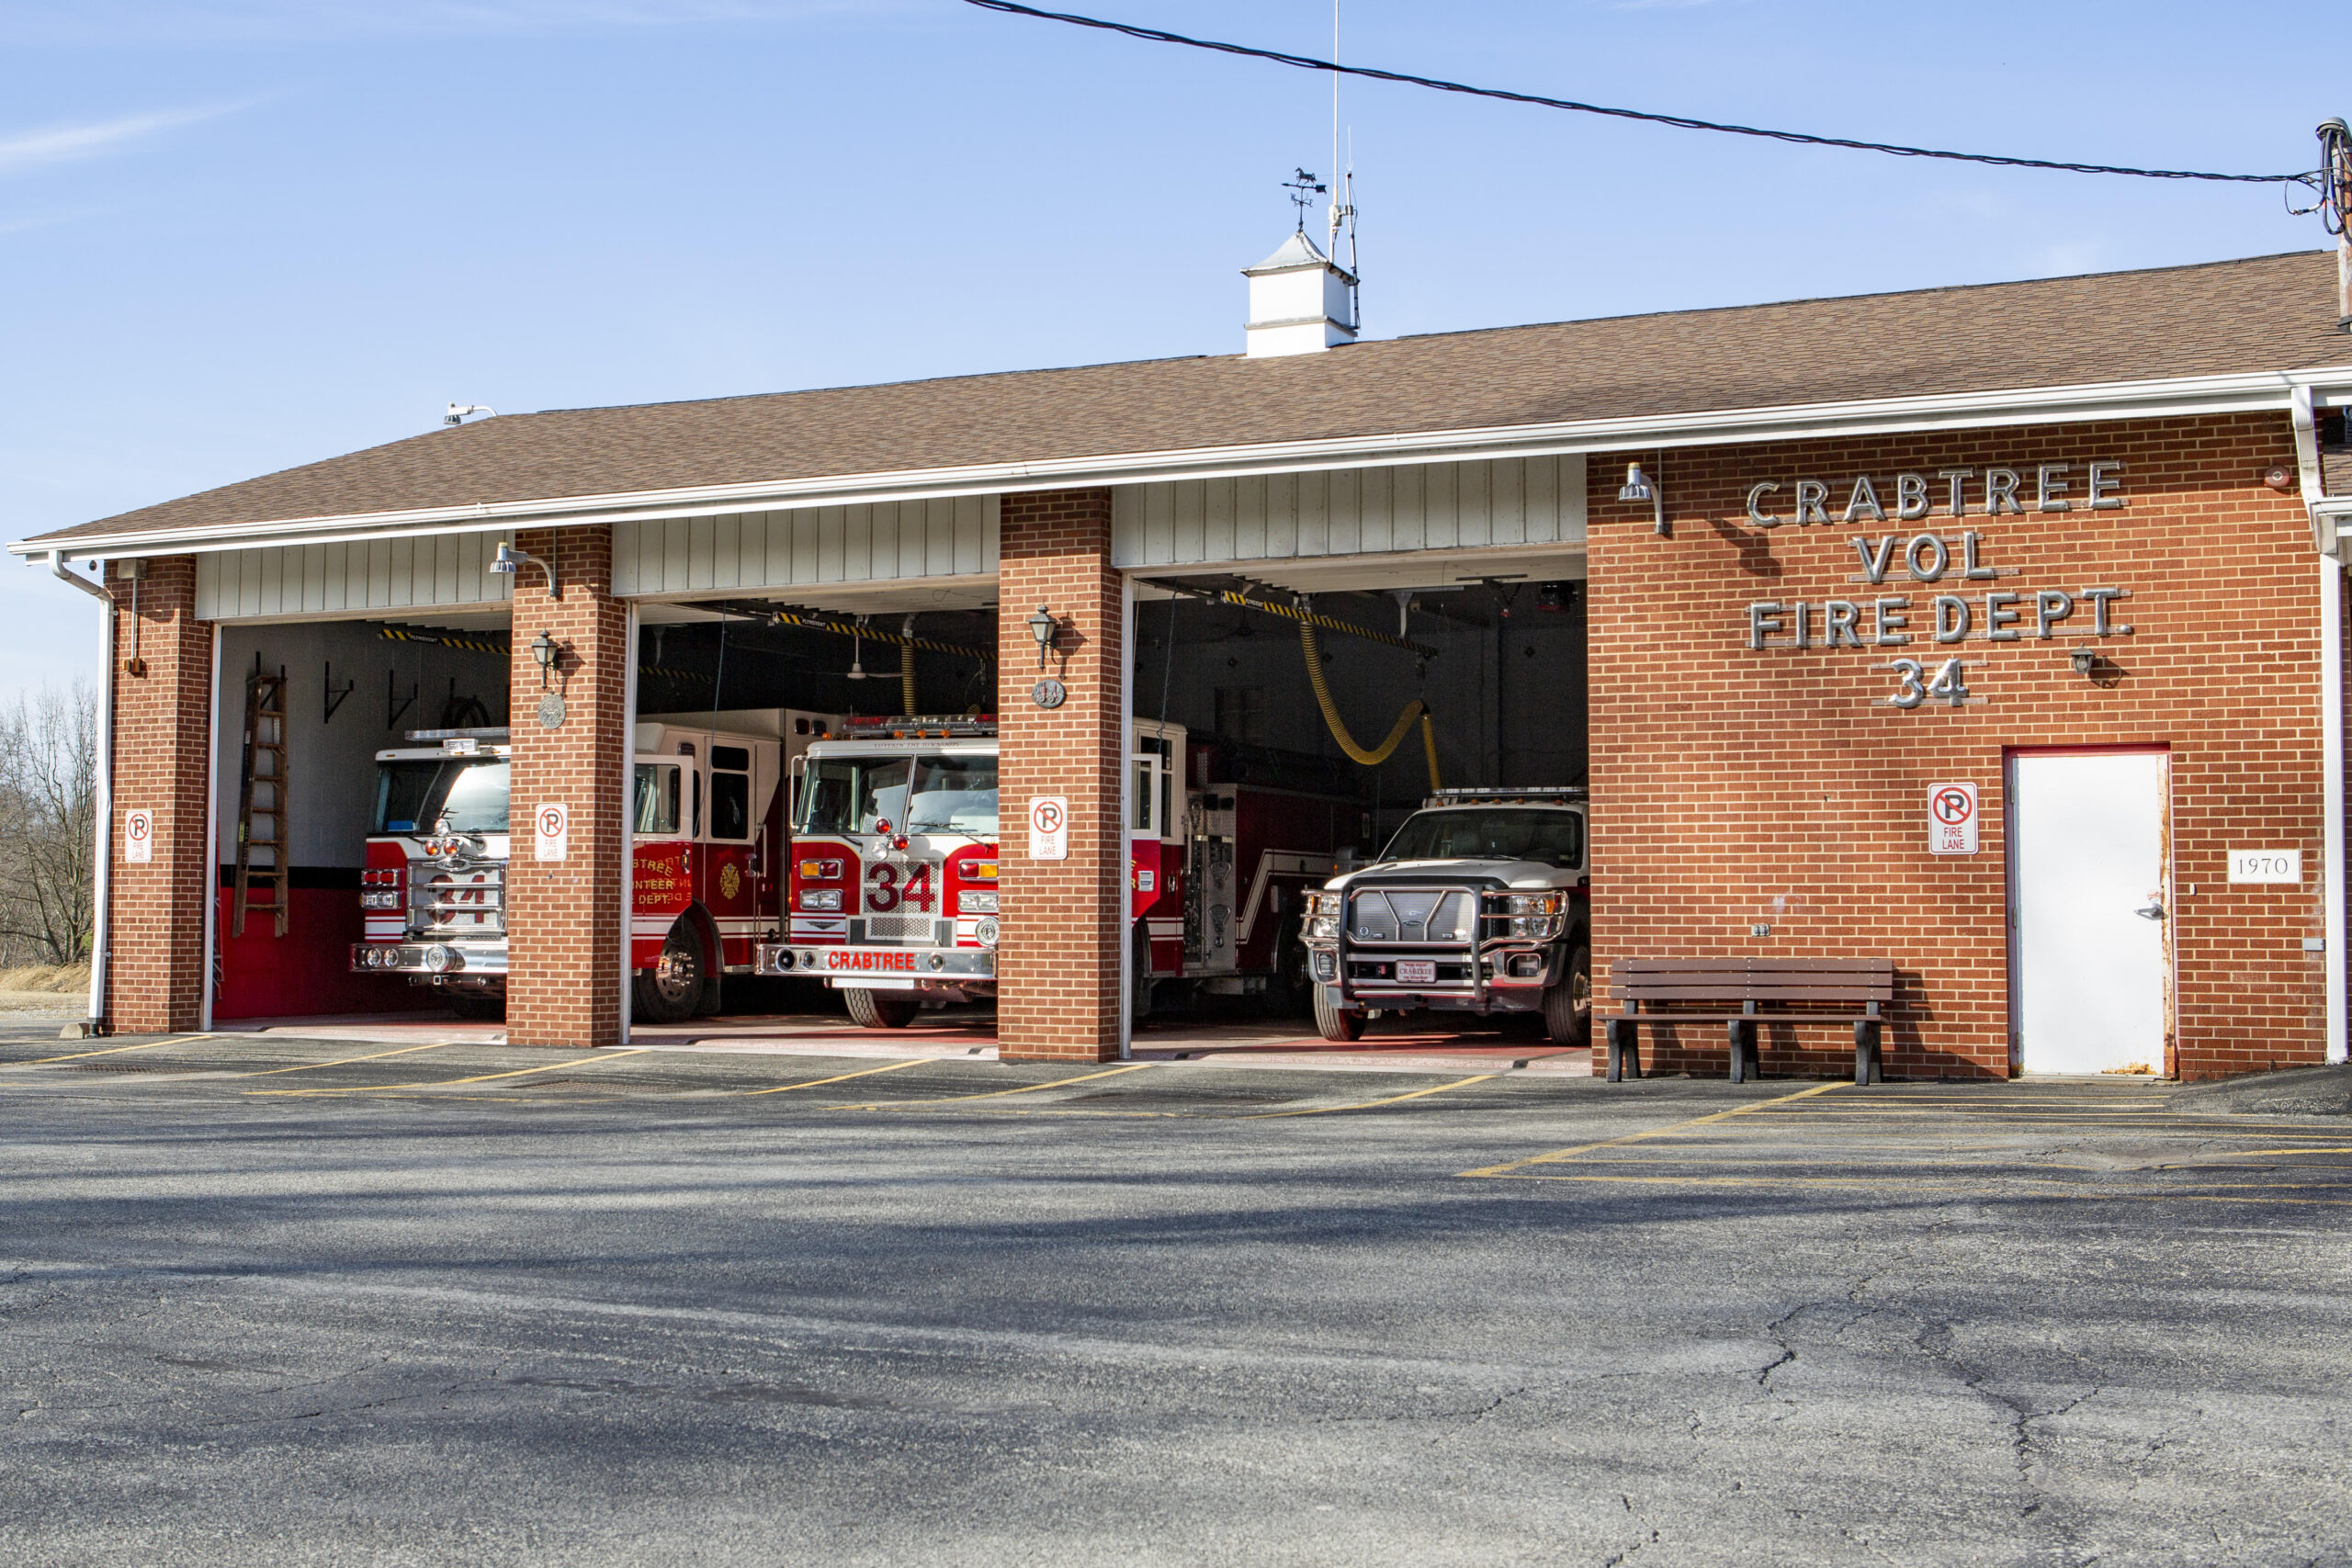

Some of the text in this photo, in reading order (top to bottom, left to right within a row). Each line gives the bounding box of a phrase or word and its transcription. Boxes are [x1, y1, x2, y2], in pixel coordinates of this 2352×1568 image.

[1747, 460, 2120, 528] CRABTREE
[1852, 531, 1995, 583] VOL
[1750, 587, 2132, 649] FIRE DEPT.
[1889, 658, 1967, 708] 34
[1040, 835, 1056, 845] FIRE
[1943, 827, 1962, 837] FIRE
[1039, 845, 1057, 855] LANE
[1942, 839, 1965, 850] LANE
[2239, 857, 2289, 874] 1970
[632, 880, 674, 890] NTEER
[867, 863, 935, 912] 34
[426, 874, 485, 925] 34
[639, 895, 671, 905] DEPT.
[828, 951, 915, 970] CRABTREE
